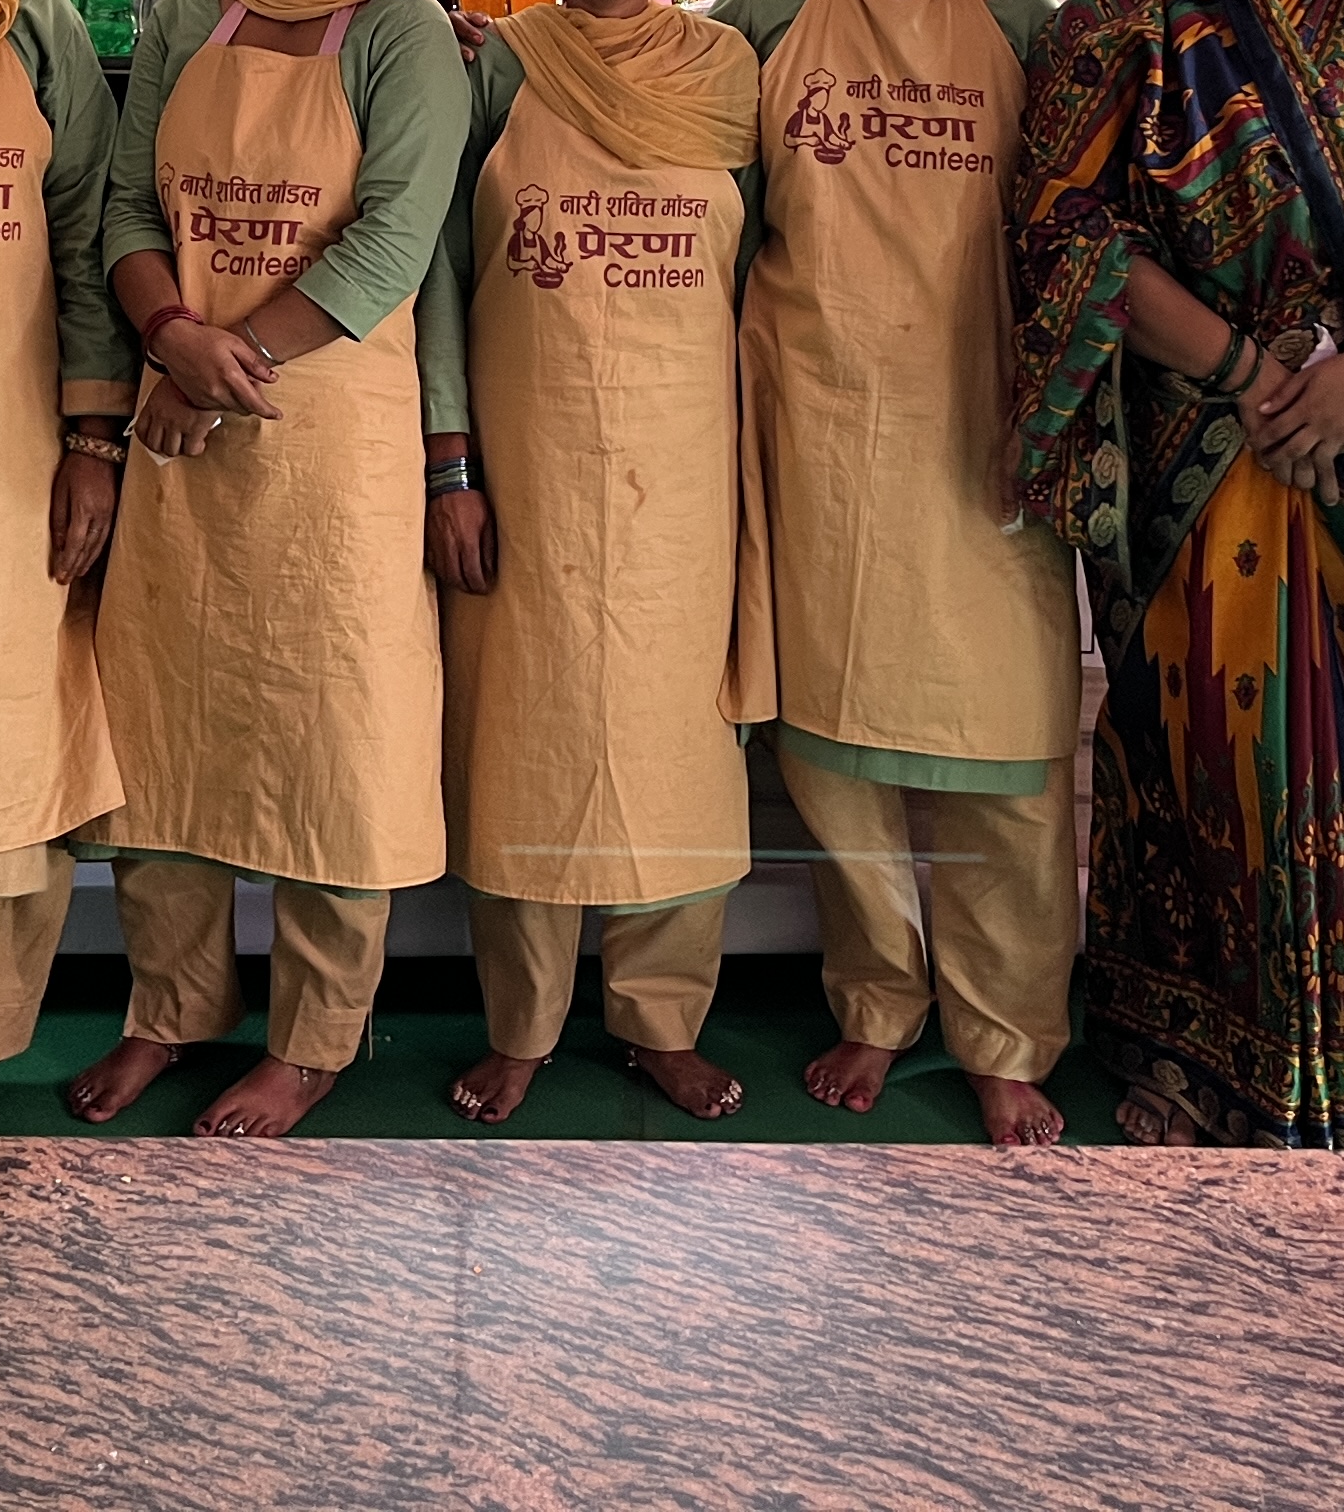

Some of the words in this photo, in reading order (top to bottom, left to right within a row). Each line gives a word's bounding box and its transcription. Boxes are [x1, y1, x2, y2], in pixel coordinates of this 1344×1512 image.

[846, 73, 882, 100] नारी
[886, 78, 932, 104] शक्ति
[935, 82, 985, 108] मॉडल
[859, 106, 977, 142] प्रेरणा
[885, 142, 994, 175] Canteen
[179, 172, 213, 200] नारी
[215, 175, 264, 204] शक्ति
[266, 179, 322, 207] मॉडल
[559, 190, 602, 216] नारी
[605, 190, 657, 218] शक्ति
[661, 193, 709, 219] मॉडल
[190, 205, 304, 246] प्रेरणा
[575, 223, 697, 260] प्रेरणा
[603, 262, 704, 288] Canteen
